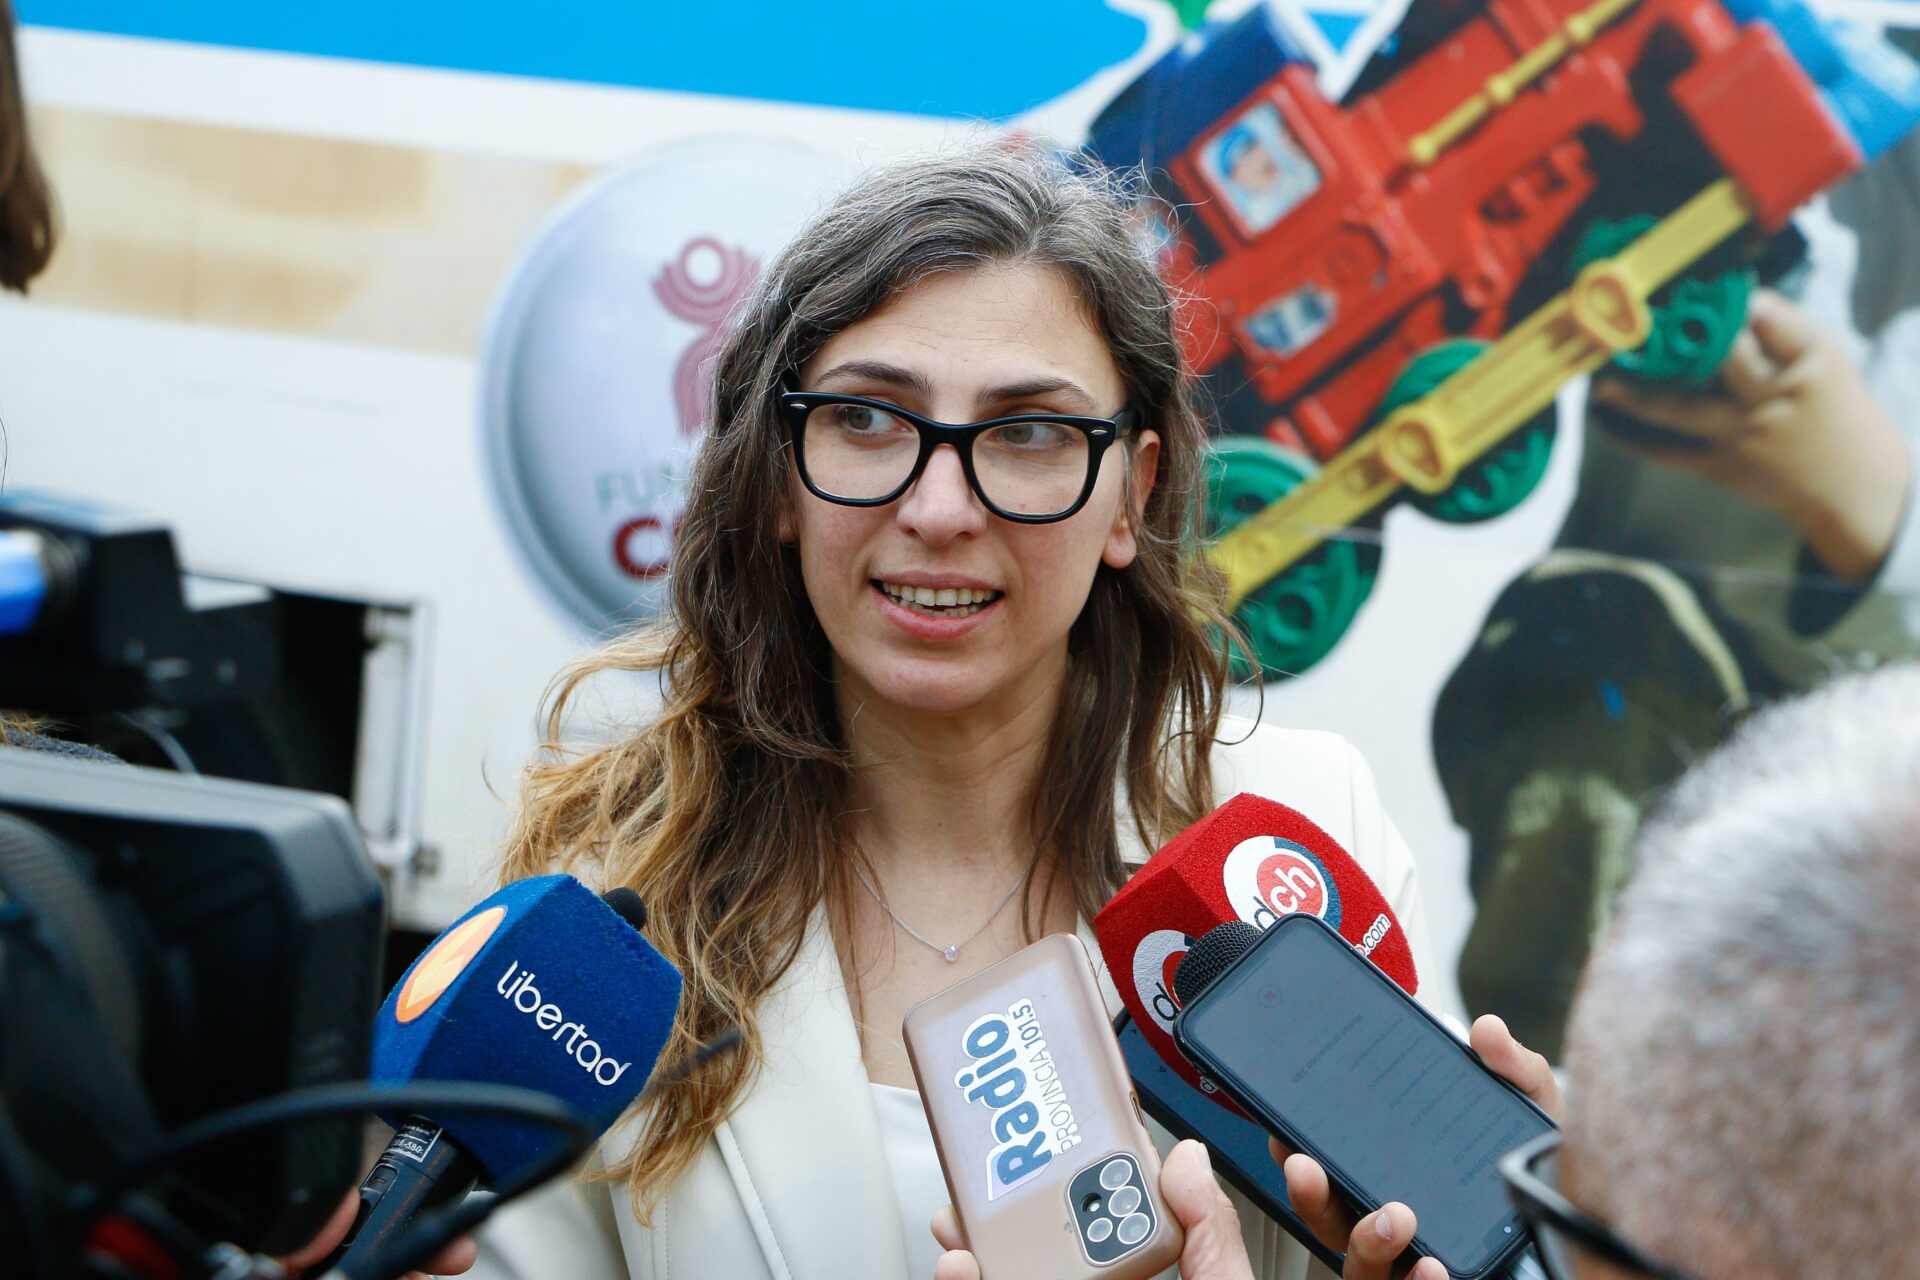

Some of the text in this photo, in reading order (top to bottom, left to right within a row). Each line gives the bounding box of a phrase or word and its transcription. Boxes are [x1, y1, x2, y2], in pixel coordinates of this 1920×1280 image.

[611, 515, 684, 580] C
[1253, 865, 1316, 933] dch
[497, 960, 632, 1085] libertad
[1012, 1004, 1074, 1152] PROVINCIA 101.5
[959, 1019, 1053, 1185] Radio
